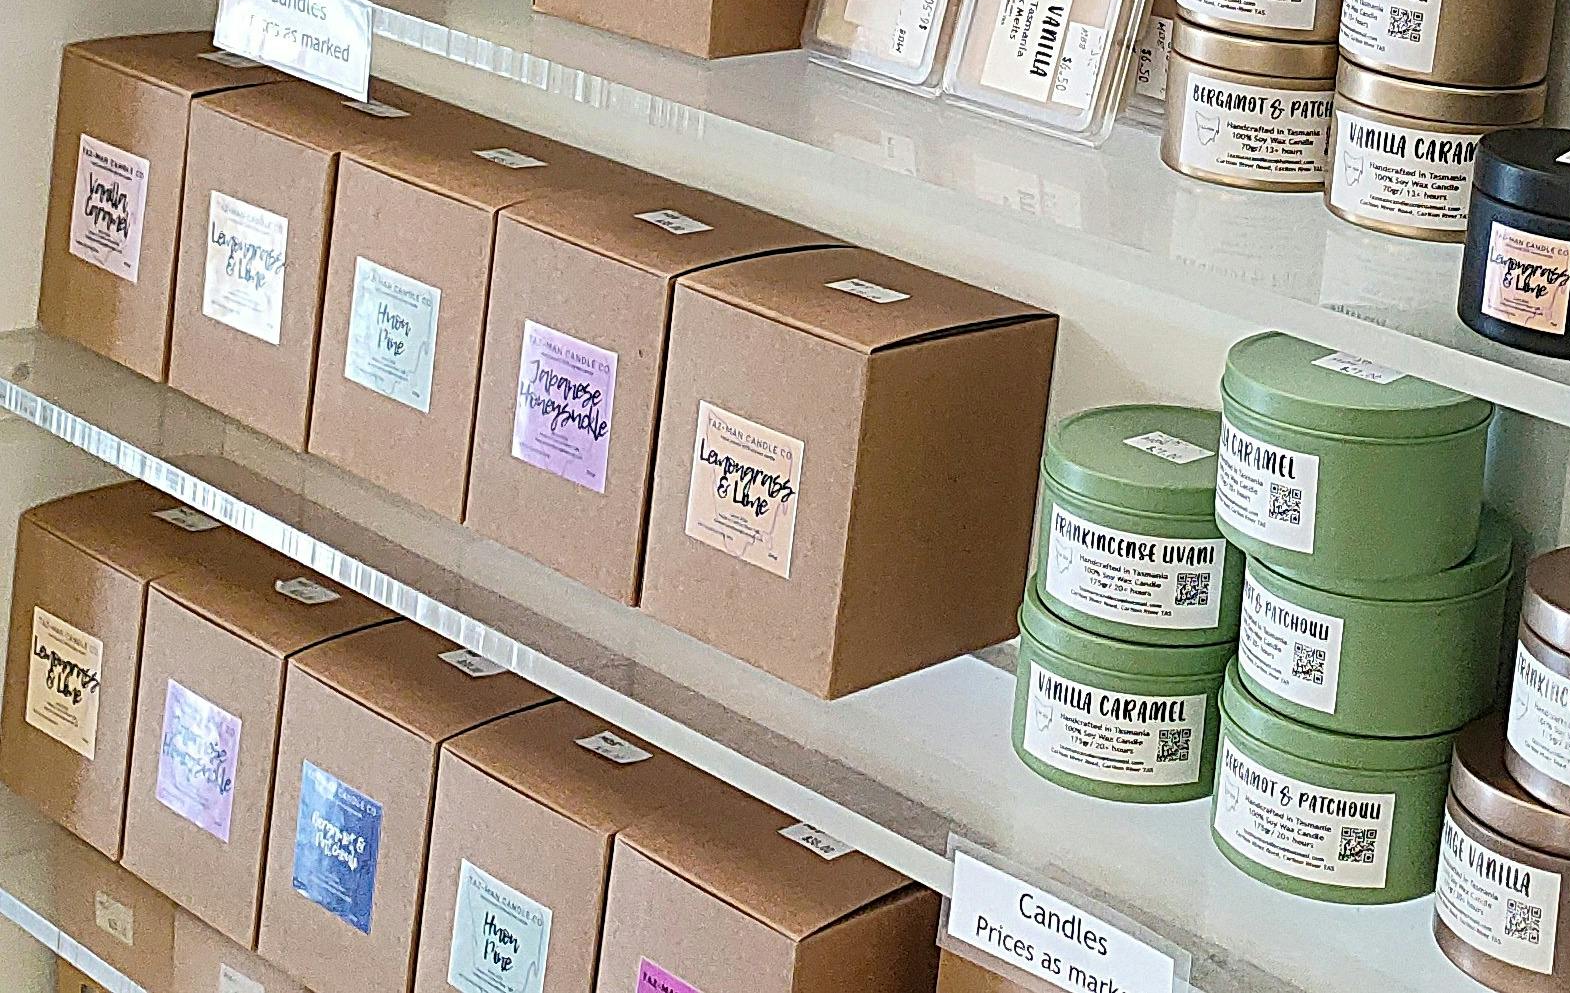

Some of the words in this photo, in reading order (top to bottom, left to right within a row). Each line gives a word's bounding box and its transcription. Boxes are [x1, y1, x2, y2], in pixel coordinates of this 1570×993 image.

[1009, 5, 1024, 41] Melts
[1017, 0, 1039, 58] Tasmania
[1029, 4, 1065, 78] VANILLA
[301, 33, 351, 62] marked
[1192, 82, 1267, 115] BERGAMOT
[1270, 98, 1285, 120] &
[1349, 121, 1406, 159] VANILLA
[1369, 160, 1416, 179] Handcrafted
[1418, 171, 1427, 180] in
[530, 360, 603, 407] Japanese
[598, 361, 610, 374] CO
[745, 434, 778, 455] CANDLE
[780, 448, 793, 460] CO
[1231, 432, 1297, 480] CARAMEL
[700, 437, 796, 503] Lemongrass
[717, 475, 730, 499] &
[732, 480, 770, 517] Lime
[1055, 512, 1156, 563] FRANKINCENSE
[1079, 553, 1121, 573] Handcrafted
[1123, 566, 1131, 574] in
[1037, 669, 1092, 715] VANILLA
[1099, 694, 1187, 724] CARAMEL
[1060, 712, 1103, 731] Handcrafted
[1105, 724, 1113, 732] in
[1279, 785, 1293, 807] &
[1286, 811, 1294, 823] in
[1295, 816, 1333, 833] Tasmania
[1468, 840, 1531, 898] VANILLA
[483, 911, 520, 954] Huon
[1019, 893, 1109, 956] Candles
[483, 939, 514, 972] Pine
[976, 915, 1035, 962] Prices
[1041, 951, 1061, 975] as
